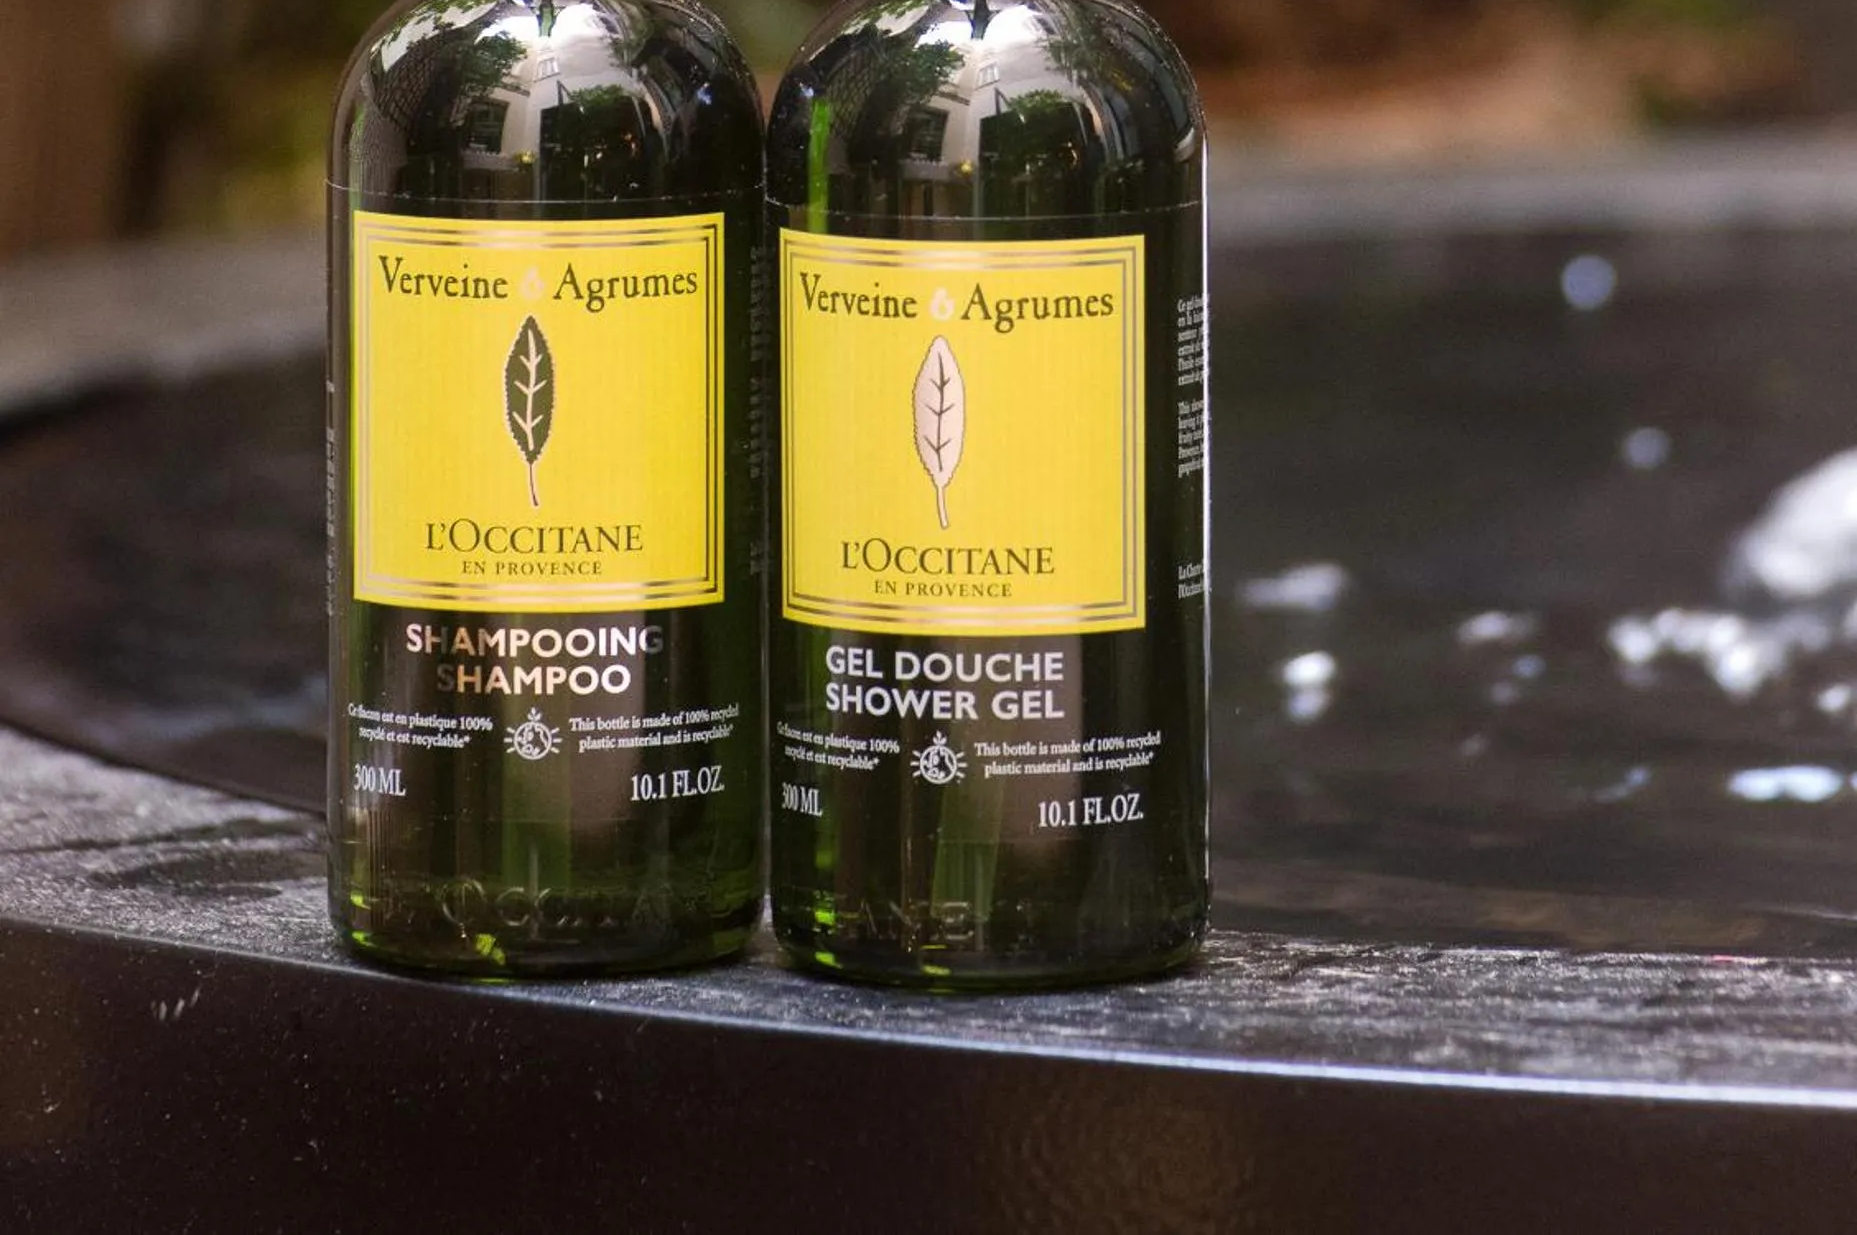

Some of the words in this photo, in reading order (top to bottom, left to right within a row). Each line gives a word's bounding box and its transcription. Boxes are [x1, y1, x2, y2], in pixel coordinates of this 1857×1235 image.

[379, 255, 508, 298] Verveine
[553, 262, 697, 313] Agrumes
[800, 271, 918, 319] Verveine
[960, 282, 1114, 333] Agrumes
[425, 518, 643, 555] L'OCCITANE
[462, 561, 486, 575] EN
[495, 561, 603, 576] PROVENCE
[841, 538, 1055, 576] L'OCCITANE
[874, 580, 897, 595] EN
[905, 581, 1012, 598] PROVENCE
[406, 623, 664, 658] SHAMPOOING
[826, 645, 883, 679] GEL
[895, 651, 1064, 682] DOUCHE
[437, 664, 632, 696] SHAMPOO
[825, 682, 979, 720] SHOWER
[992, 690, 1065, 720] GEL
[409, 713, 457, 731] plastique
[459, 716, 494, 732] 100%
[569, 716, 596, 732] This
[597, 715, 631, 731] bottle
[632, 714, 641, 729] is
[642, 712, 672, 728] made
[672, 710, 685, 725] of
[685, 709, 710, 724] 100%
[578, 735, 617, 753] plastic
[617, 732, 662, 749] material
[662, 730, 682, 745] and
[683, 729, 691, 743] is
[869, 738, 900, 754] 100%
[974, 741, 1001, 757] This
[1002, 741, 1037, 756] bottle
[1039, 741, 1048, 755] is
[1051, 739, 1081, 754] made
[1082, 736, 1096, 752] of
[1097, 736, 1125, 752] 100%
[354, 763, 376, 792] 300
[378, 767, 406, 796] ML
[984, 761, 1022, 779] plastic
[1024, 759, 1071, 775] material
[1072, 757, 1093, 772] and
[1095, 757, 1105, 771] is
[630, 773, 668, 802] 10.1
[800, 785, 823, 817] ML
[1038, 800, 1078, 828] 10.1
[1082, 793, 1144, 825] FL.OZ.
